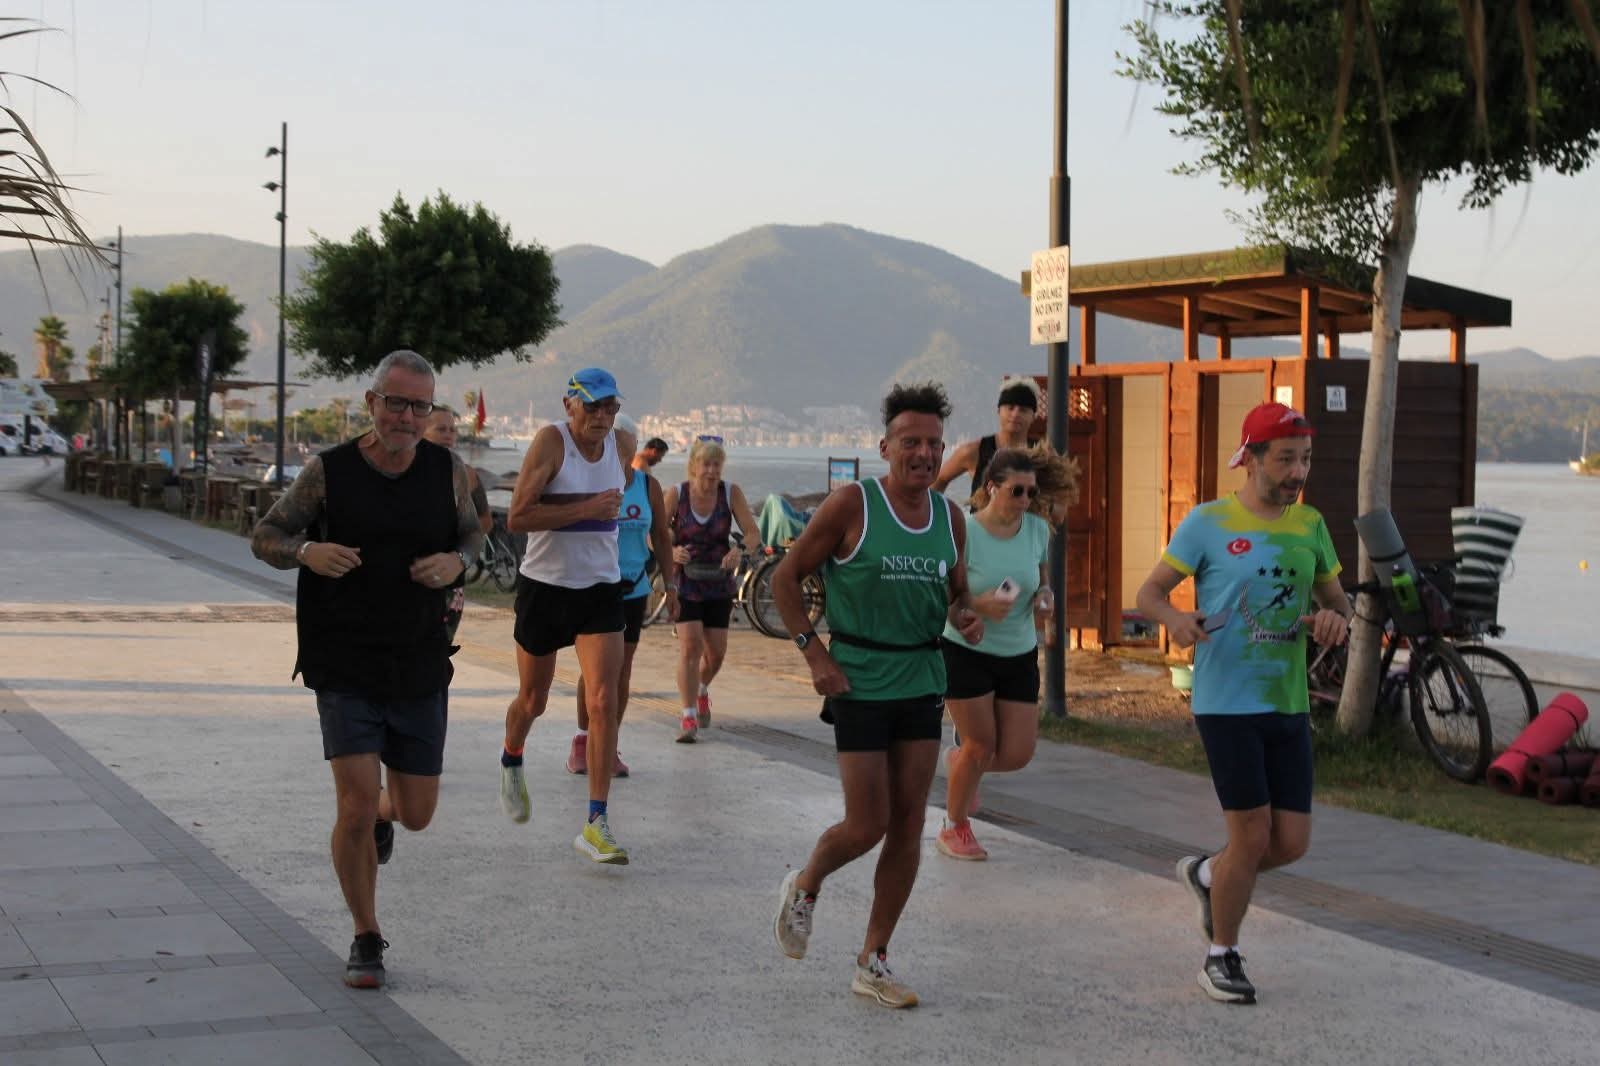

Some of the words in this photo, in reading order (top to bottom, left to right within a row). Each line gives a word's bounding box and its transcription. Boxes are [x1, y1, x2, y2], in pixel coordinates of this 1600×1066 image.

[1035, 306, 1044, 317] NO
[1045, 303, 1063, 315] ENTRY
[881, 556, 936, 574] NSPCC
